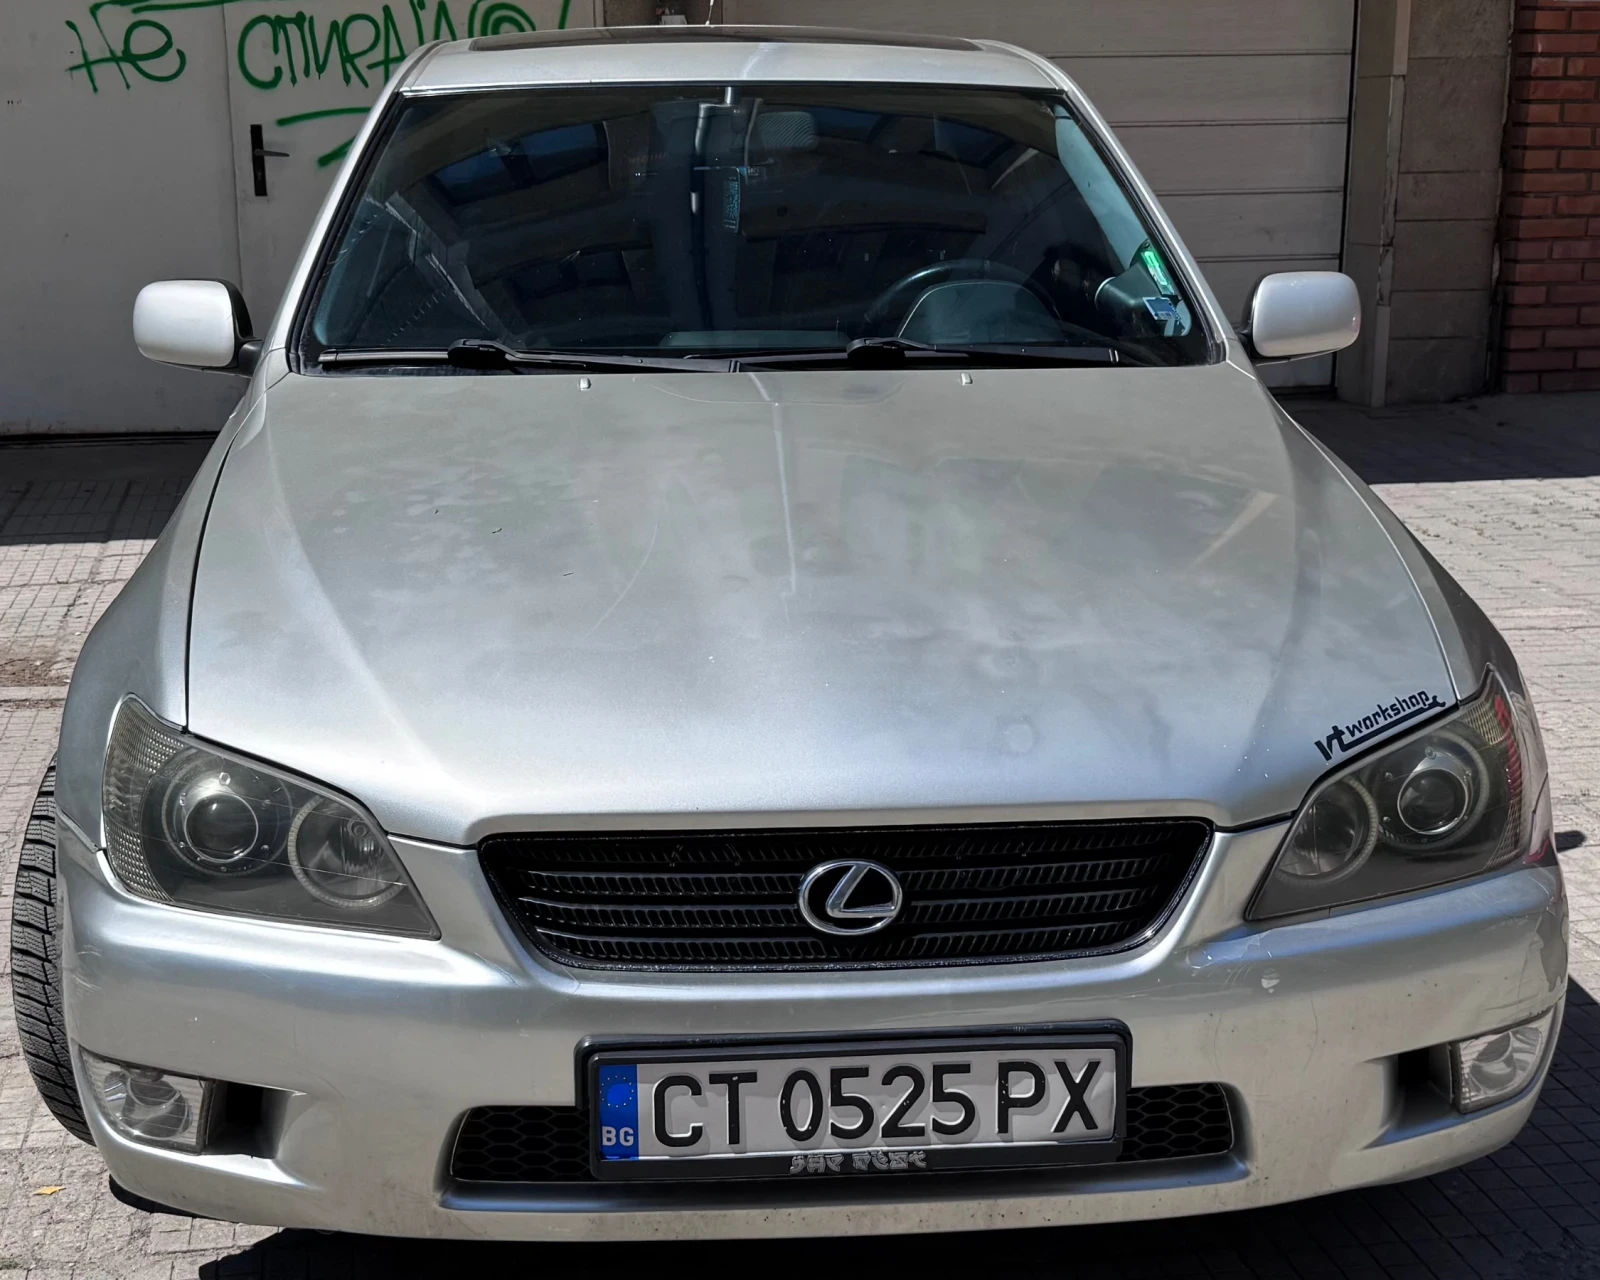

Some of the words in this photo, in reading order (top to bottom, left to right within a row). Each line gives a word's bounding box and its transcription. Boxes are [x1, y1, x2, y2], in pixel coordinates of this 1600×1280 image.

[1345, 690, 1430, 738] workshop
[653, 1071, 758, 1148] CT
[779, 1063, 976, 1142] 0525
[996, 1060, 1102, 1135] PX
[601, 1125, 634, 1147] BG
